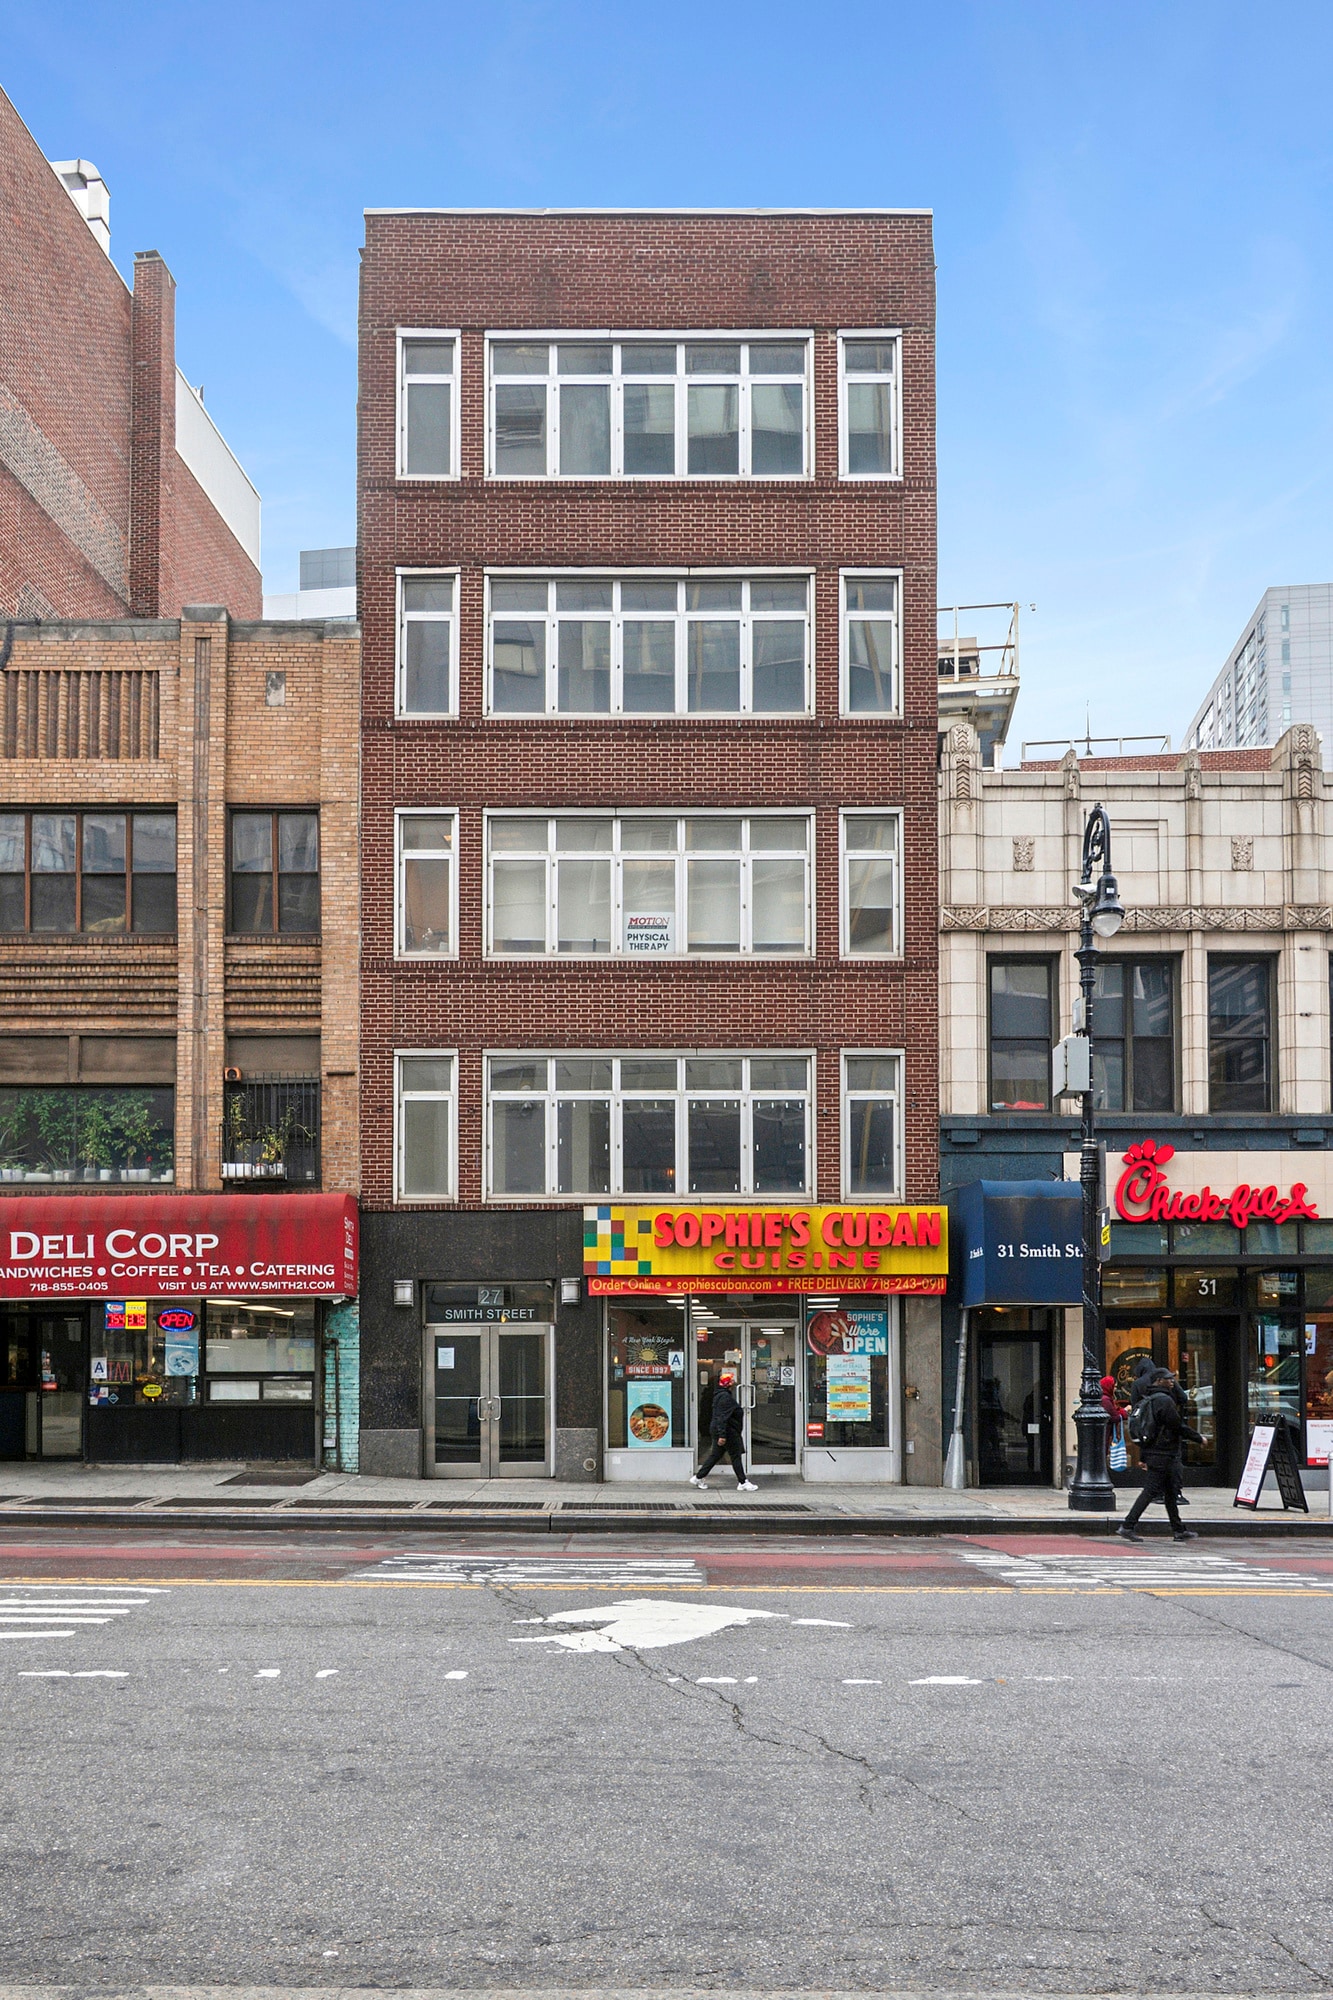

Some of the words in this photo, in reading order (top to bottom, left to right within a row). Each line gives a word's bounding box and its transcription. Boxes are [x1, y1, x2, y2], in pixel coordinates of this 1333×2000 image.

[629, 917, 670, 925] MOTION
[627, 933, 670, 941] PHYSICAL
[629, 942, 668, 950] THERAPY
[654, 1212, 811, 1248] SOPHIE'S
[822, 1212, 941, 1247] CUBAN
[997, 1244, 1015, 1258] 31
[1020, 1243, 1061, 1258] Smith
[1065, 1244, 1084, 1258] St.
[714, 1251, 881, 1269] CUISINE
[30, 1282, 108, 1291] 718-855-0405
[158, 1282, 187, 1290] VISIT
[191, 1282, 207, 1290] US
[210, 1281, 224, 1290] AT
[227, 1280, 335, 1290] WWW.SMITH21.COM
[592, 1278, 625, 1291] Order
[628, 1278, 661, 1291] Online
[677, 1277, 772, 1292] sophiescuban.com
[788, 1277, 814, 1290] FREE
[816, 1277, 868, 1290] DELIVERY
[872, 1277, 944, 1290] 718-243-0911
[1198, 1279, 1216, 1295] 31
[480, 1289, 500, 1304] 27
[159, 1313, 194, 1327] OPEN
[445, 1309, 483, 1319] SMITH
[486, 1309, 535, 1319] STREET
[848, 1324, 880, 1336] We're
[842, 1337, 886, 1352] OPEN
[671, 1354, 681, 1365] A
[94, 1362, 104, 1373] A
[107, 1362, 131, 1381] TM
